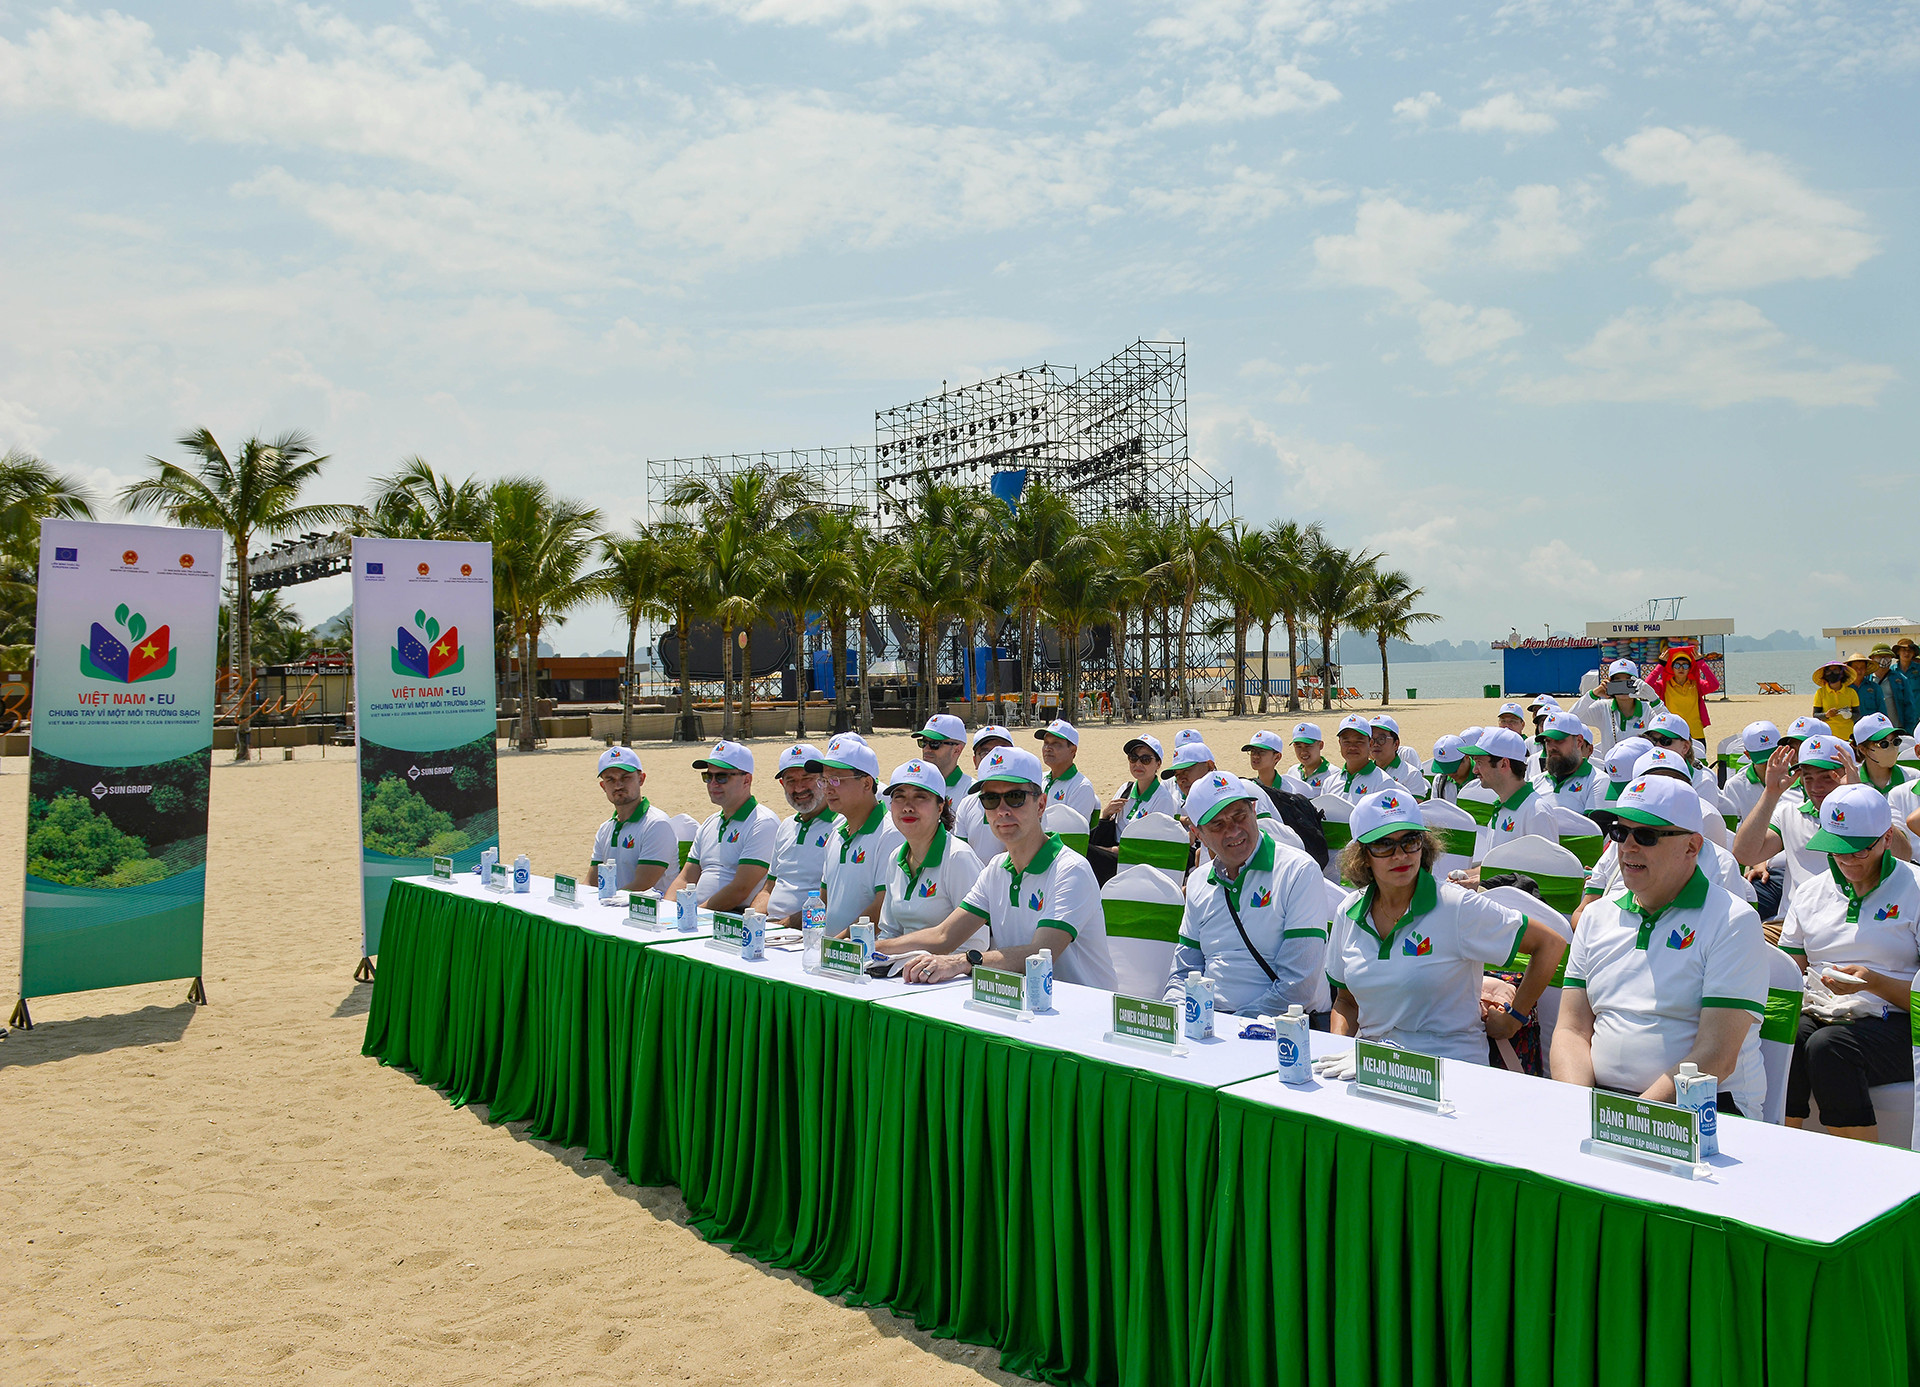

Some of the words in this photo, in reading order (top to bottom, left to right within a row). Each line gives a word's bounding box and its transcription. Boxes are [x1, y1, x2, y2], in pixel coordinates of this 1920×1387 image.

[1643, 624, 1661, 632] PHAO
[1523, 636, 1545, 649] Kem
[319, 667, 349, 675] Beach
[78, 690, 110, 707] VIỆT
[113, 693, 146, 705] NAM
[157, 693, 175, 705] EU
[392, 685, 416, 700] VIỆT
[418, 686, 444, 698] NAM
[452, 686, 466, 696] EU
[370, 703, 394, 711] CHUNG
[430, 700, 442, 708] MÔI
[48, 709, 79, 717] CHUNG
[80, 709, 96, 717] TAY
[97, 708, 105, 717] VÌ
[107, 708, 126, 718] MỘT
[127, 708, 143, 717] MÔI
[145, 708, 178, 717] TRƯỜNG
[179, 709, 200, 718] SẠCH
[421, 767, 434, 776] SUN
[434, 766, 454, 775] GROUP
[109, 785, 126, 795] SUN
[126, 785, 153, 794] GROUP
[824, 947, 839, 960] JULIEN
[977, 978, 995, 993] PAVLIN
[1119, 1008, 1137, 1024] CARMEN
[1149, 1013, 1155, 1028] DE
[1393, 1052, 1400, 1060] Mr
[1363, 1056, 1387, 1075] KEIJO
[1388, 1061, 1432, 1086] NORVANTO
[1407, 1085, 1418, 1094] LAN
[1599, 1106, 1625, 1129] ĐẶNG
[1626, 1113, 1650, 1135] MINH
[1651, 1120, 1689, 1144] TRƯỜNG
[1660, 1144, 1672, 1154] SUN
[1671, 1147, 1690, 1159] GROUP
